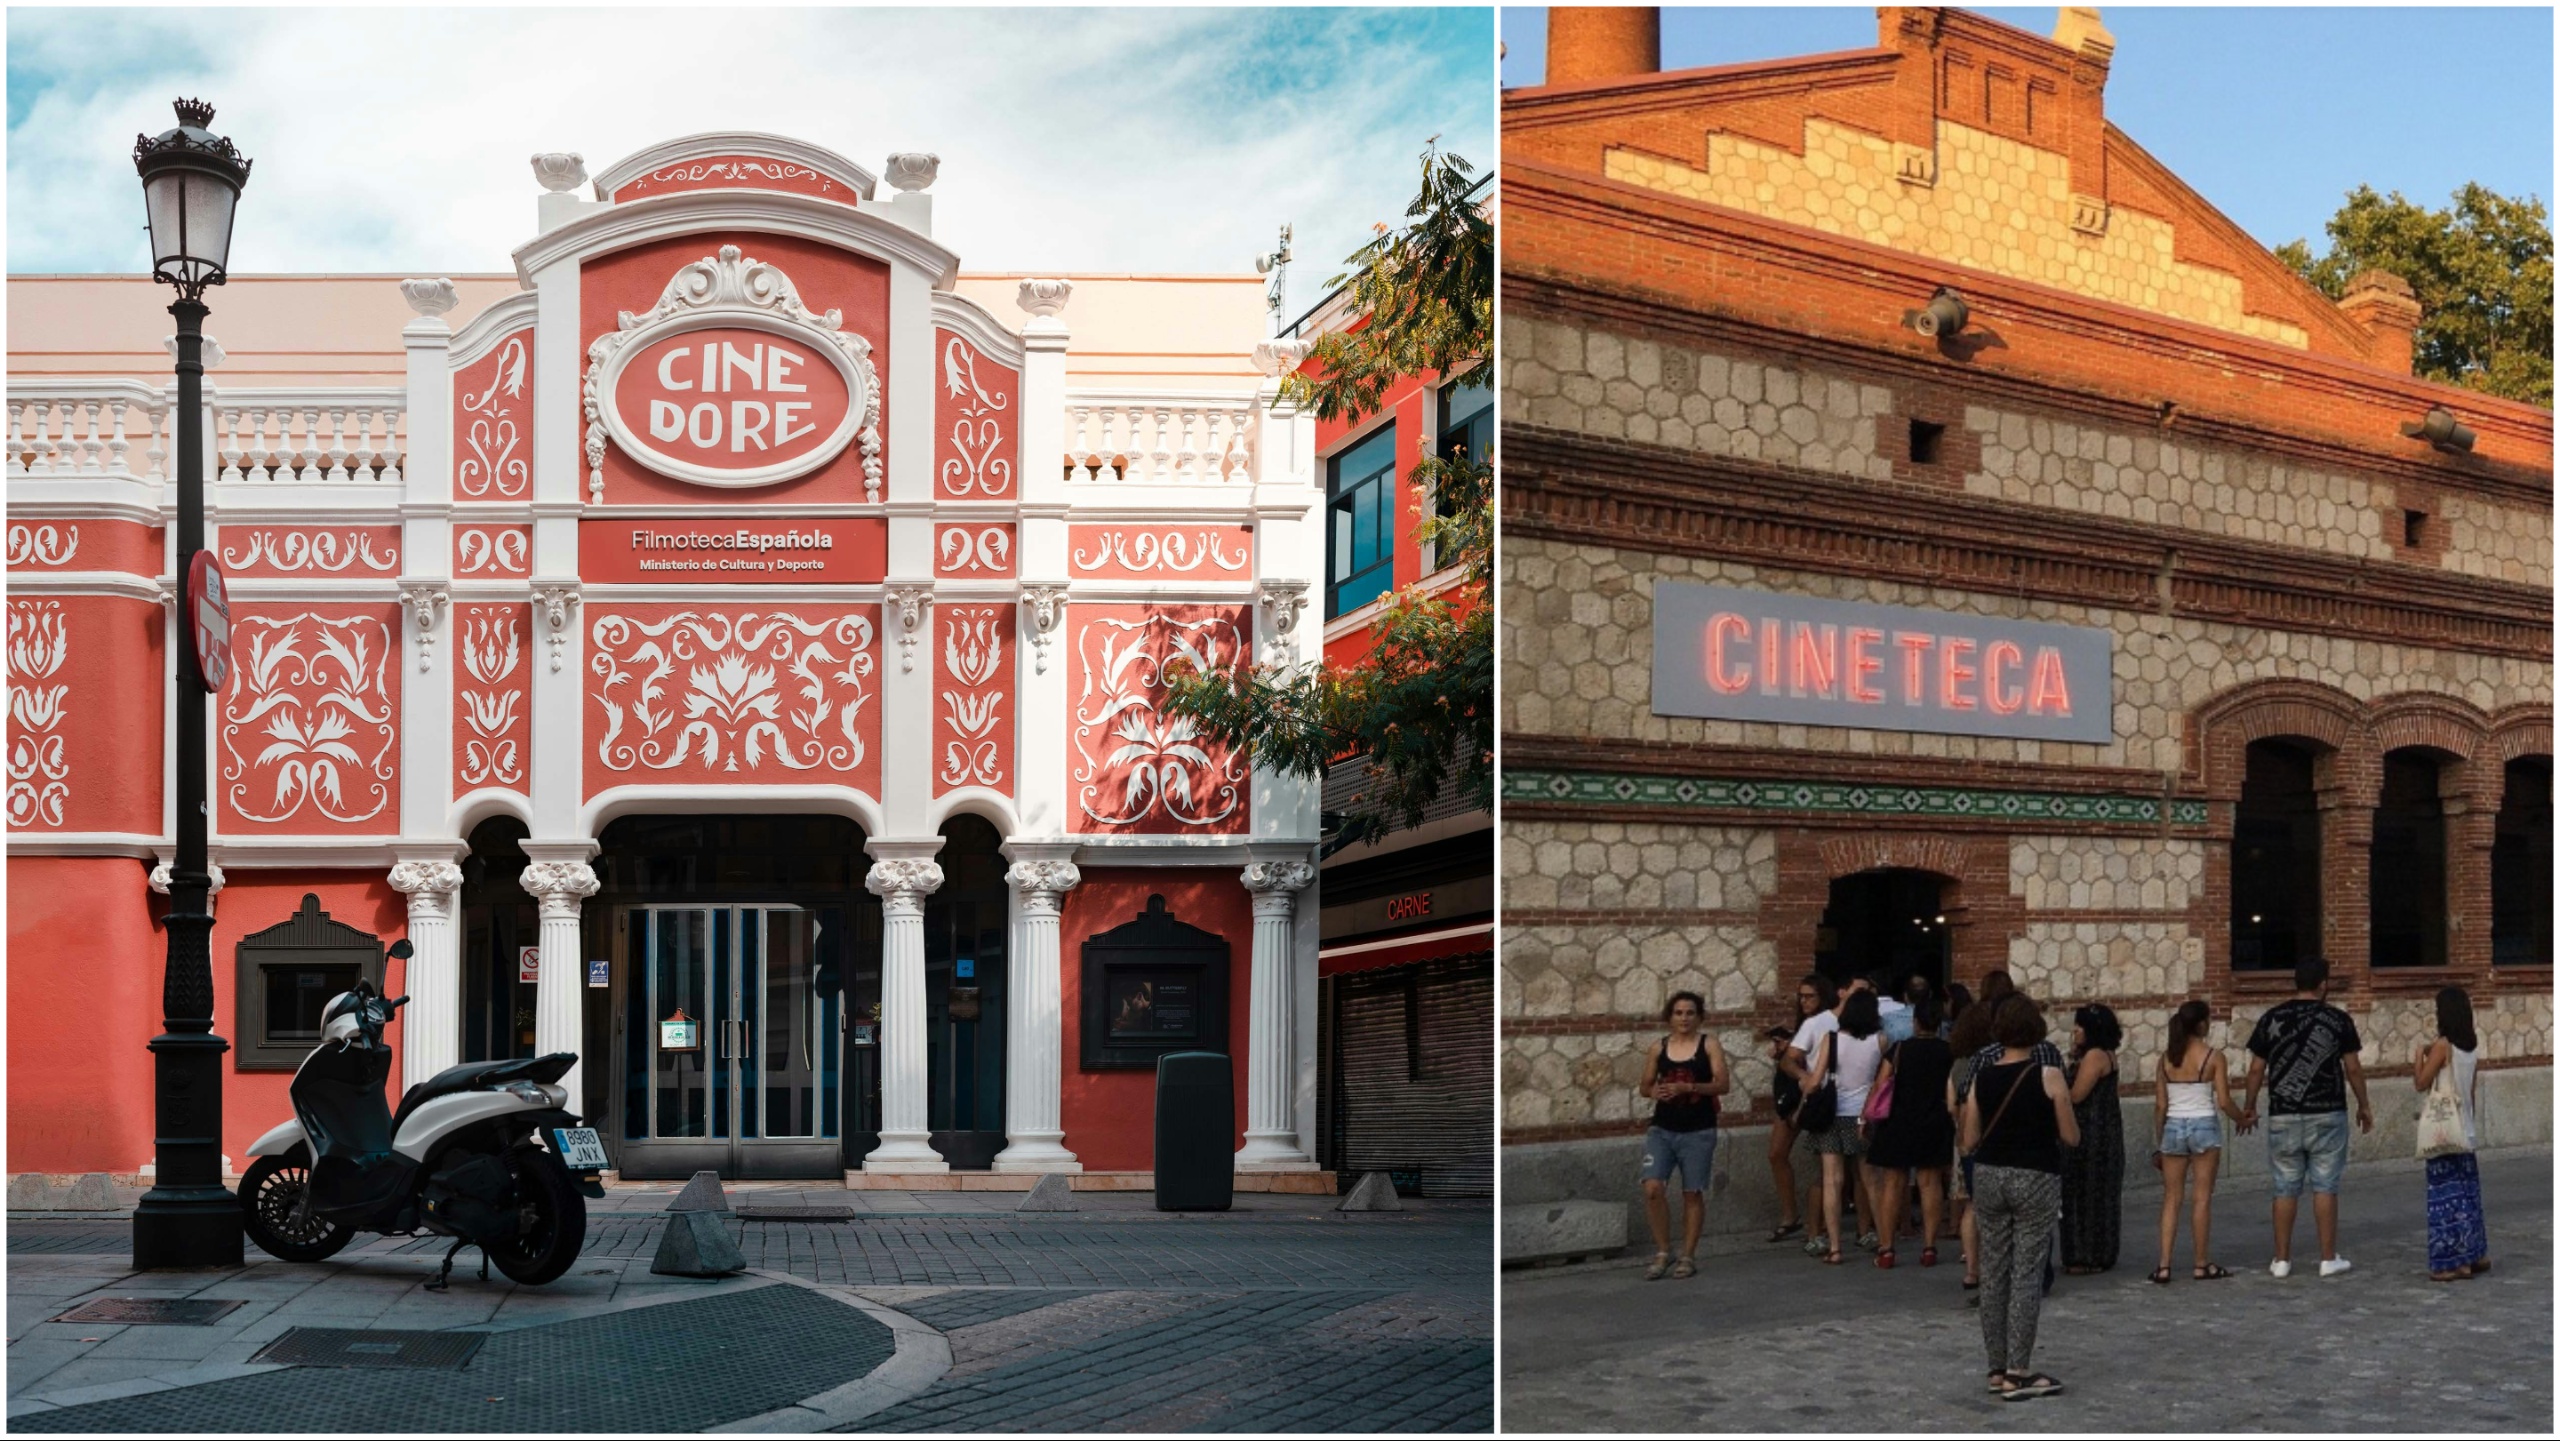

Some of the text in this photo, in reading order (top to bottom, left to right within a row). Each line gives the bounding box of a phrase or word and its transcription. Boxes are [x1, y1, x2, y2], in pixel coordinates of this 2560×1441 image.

[658, 342, 807, 393] CINE
[650, 400, 816, 453] DORE
[632, 530, 833, 553] FilmotecaEspañola
[640, 559, 825, 572] Ministerio de Cultura y Deporte
[1705, 611, 2074, 718] CINETECA
[1387, 893, 1431, 921] CARNE
[566, 1130, 597, 1145] 8980
[576, 1146, 602, 1162] JNX
